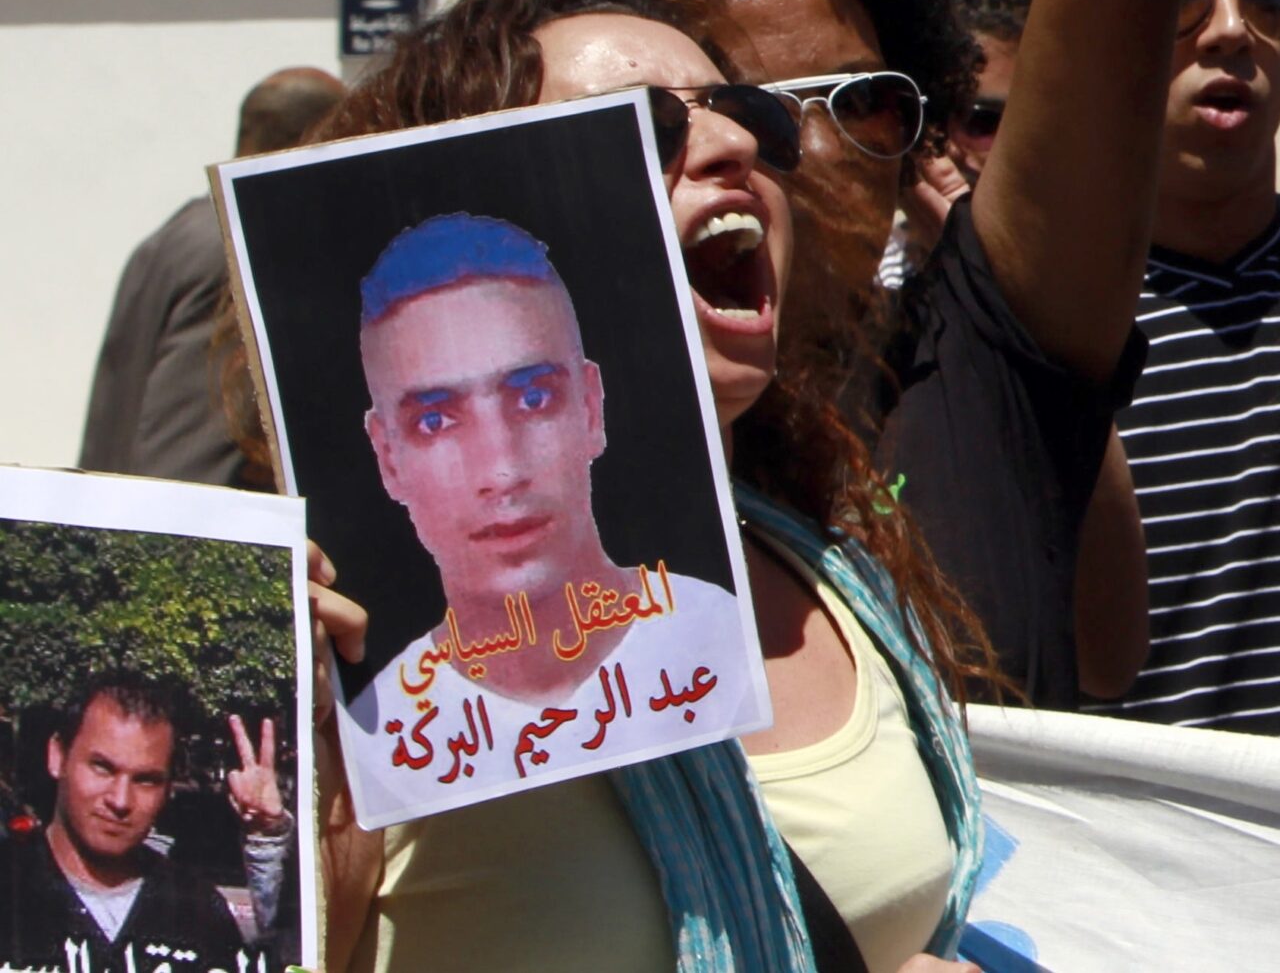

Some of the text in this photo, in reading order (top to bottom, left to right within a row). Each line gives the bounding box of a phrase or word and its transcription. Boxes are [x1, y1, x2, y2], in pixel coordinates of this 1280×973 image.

[400, 560, 675, 714] المعتقل السياسي
[384, 662, 718, 785] عبد الرحيم البركة
